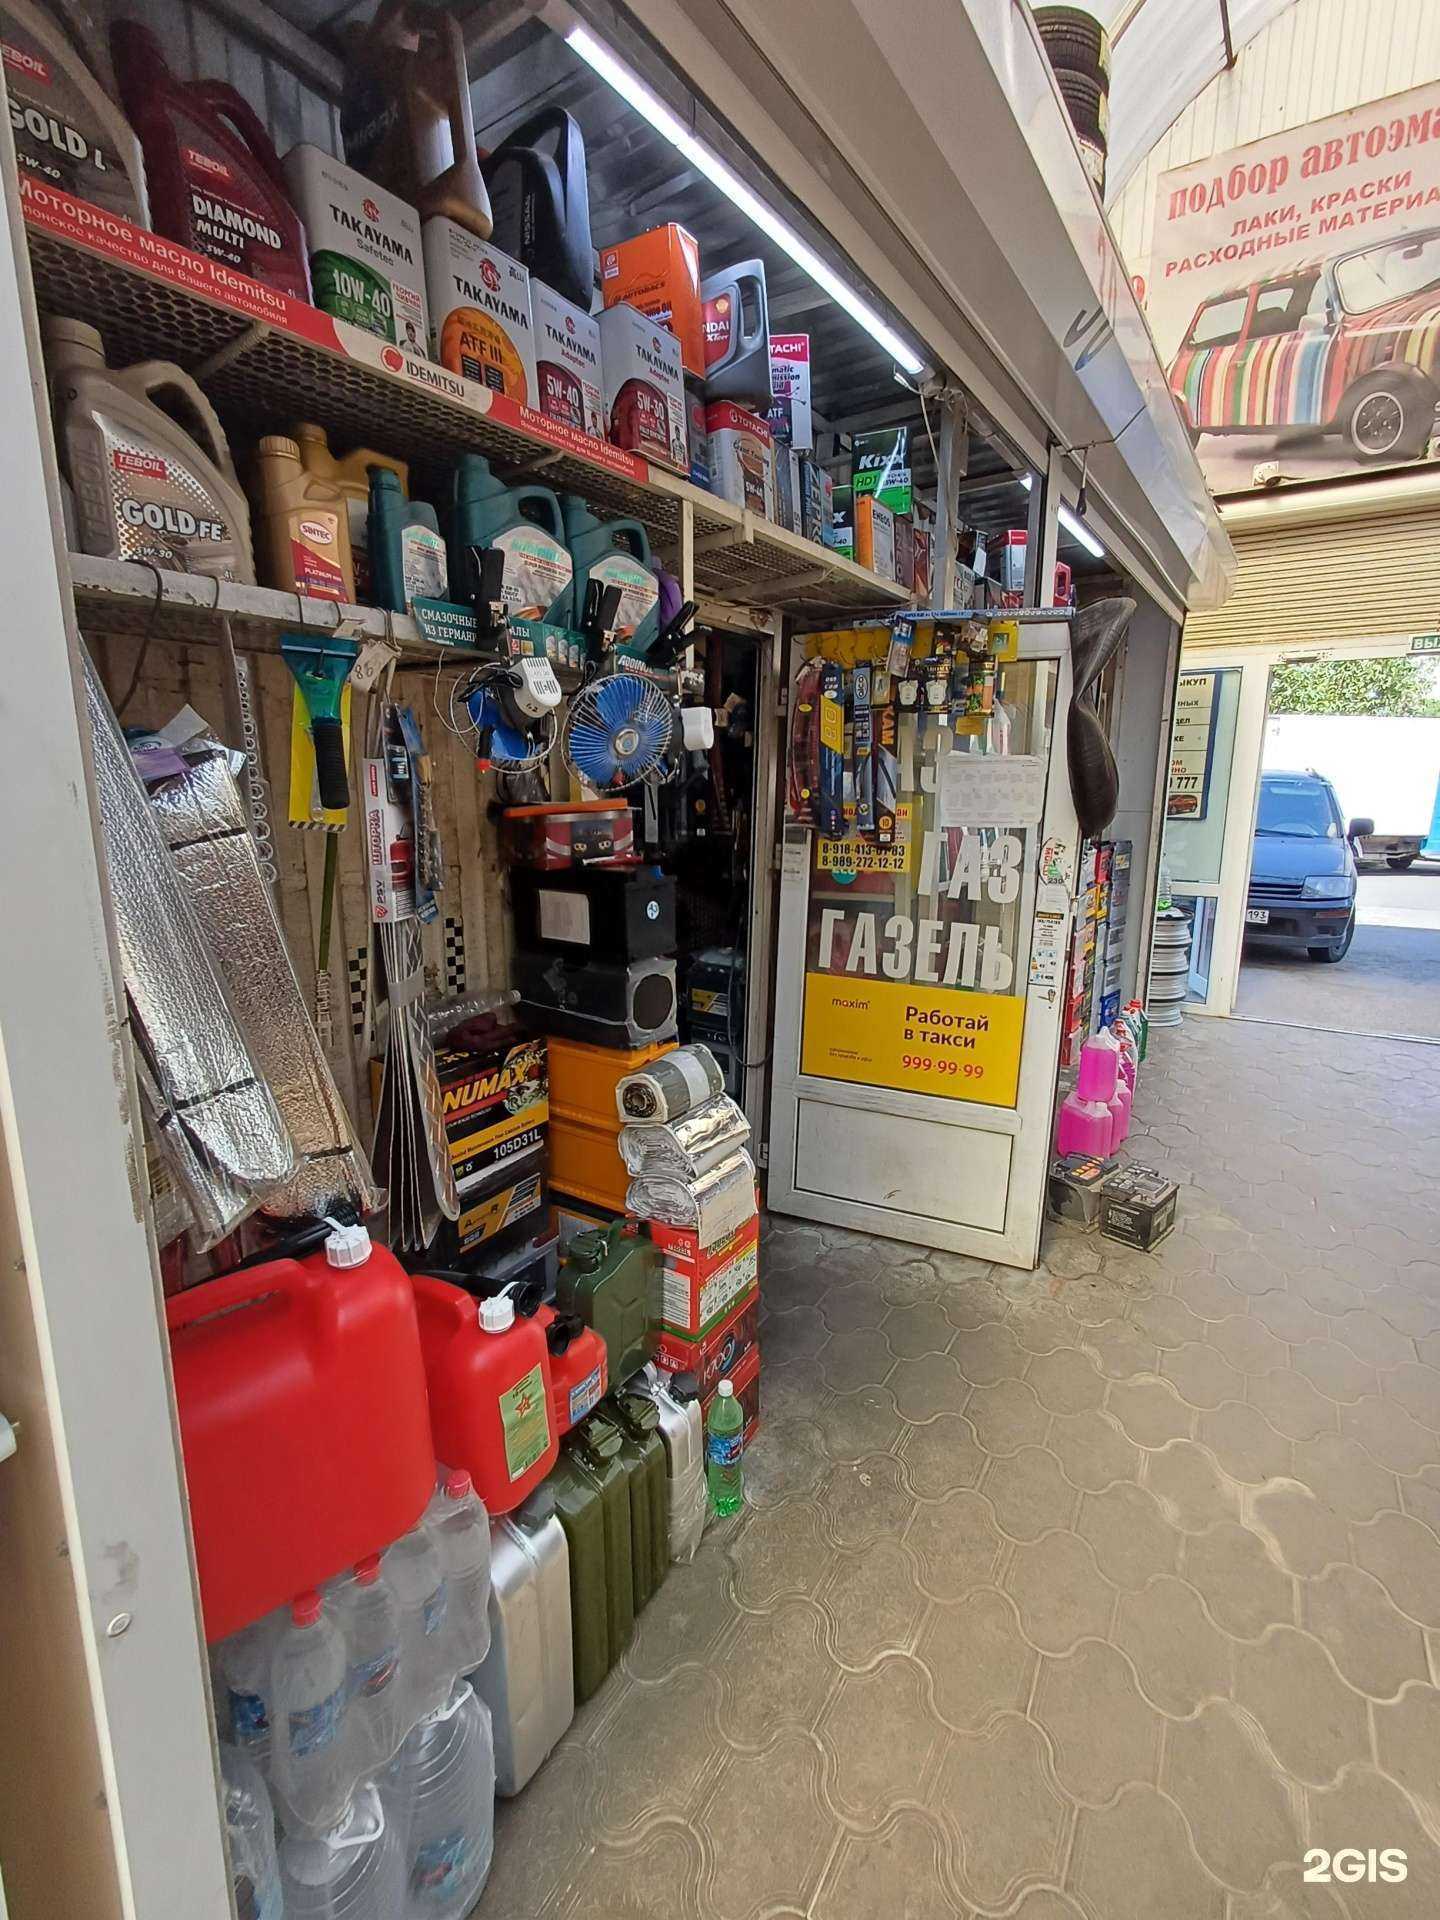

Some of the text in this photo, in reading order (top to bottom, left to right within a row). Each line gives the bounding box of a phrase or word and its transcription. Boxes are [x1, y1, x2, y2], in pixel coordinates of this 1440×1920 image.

[1, 44, 47, 77] EBOIL
[9, 98, 87, 159] GOLD
[17, 152, 61, 179] 5W-40
[1168, 155, 1289, 221] подбор
[1230, 170, 1413, 237] ЛАКИ, КРАСКИ
[192, 194, 282, 249] DIAMOND
[196, 219, 244, 248] MULTI
[329, 203, 413, 265] TAKAYAMA
[24, 205, 288, 324] понское качество для Вашего автомобиля
[206, 244, 241, 263] 5W-40
[1164, 223, 1310, 278] РАСХОДНЫЕ
[140, 236, 203, 274] масло
[210, 266, 286, 311] Idemitsu
[333, 268, 391, 318] 10W-40
[453, 275, 529, 330] TAKAYAMA
[461, 332, 486, 354] ATF
[545, 324, 597, 366] TAKAYAMA
[636, 344, 679, 381] TAKAYAMA
[405, 361, 465, 398] IDEMITSU
[546, 374, 579, 407] 5W-40
[637, 391, 664, 420] 5W-30
[767, 407, 783, 419] ATF
[520, 406, 569, 436] Моторное
[571, 432, 598, 450] масло
[600, 443, 634, 466] Idemitsu
[739, 417, 768, 439] TOTACHI
[117, 454, 163, 472] TEBOIL
[121, 498, 224, 542] GOLD FE
[302, 525, 331, 541] SINTEC
[873, 510, 891, 528] ENEOS
[136, 546, 173, 560] 5W-30
[421, 608, 479, 628] СМАЗОЧНЫЕ
[424, 623, 437, 636] ИЗ
[1177, 776, 1198, 790] 777
[367, 809, 382, 866] ШТОРКА
[917, 830, 1023, 904] ГАЗ
[818, 908, 1013, 991] ГАЗЕЛЬ
[832, 998, 869, 1010] maxim
[905, 1005, 989, 1032] Работай
[904, 1027, 976, 1049] в такси
[443, 1064, 525, 1113] NUMAX
[493, 1129, 542, 1160] 105D31L
